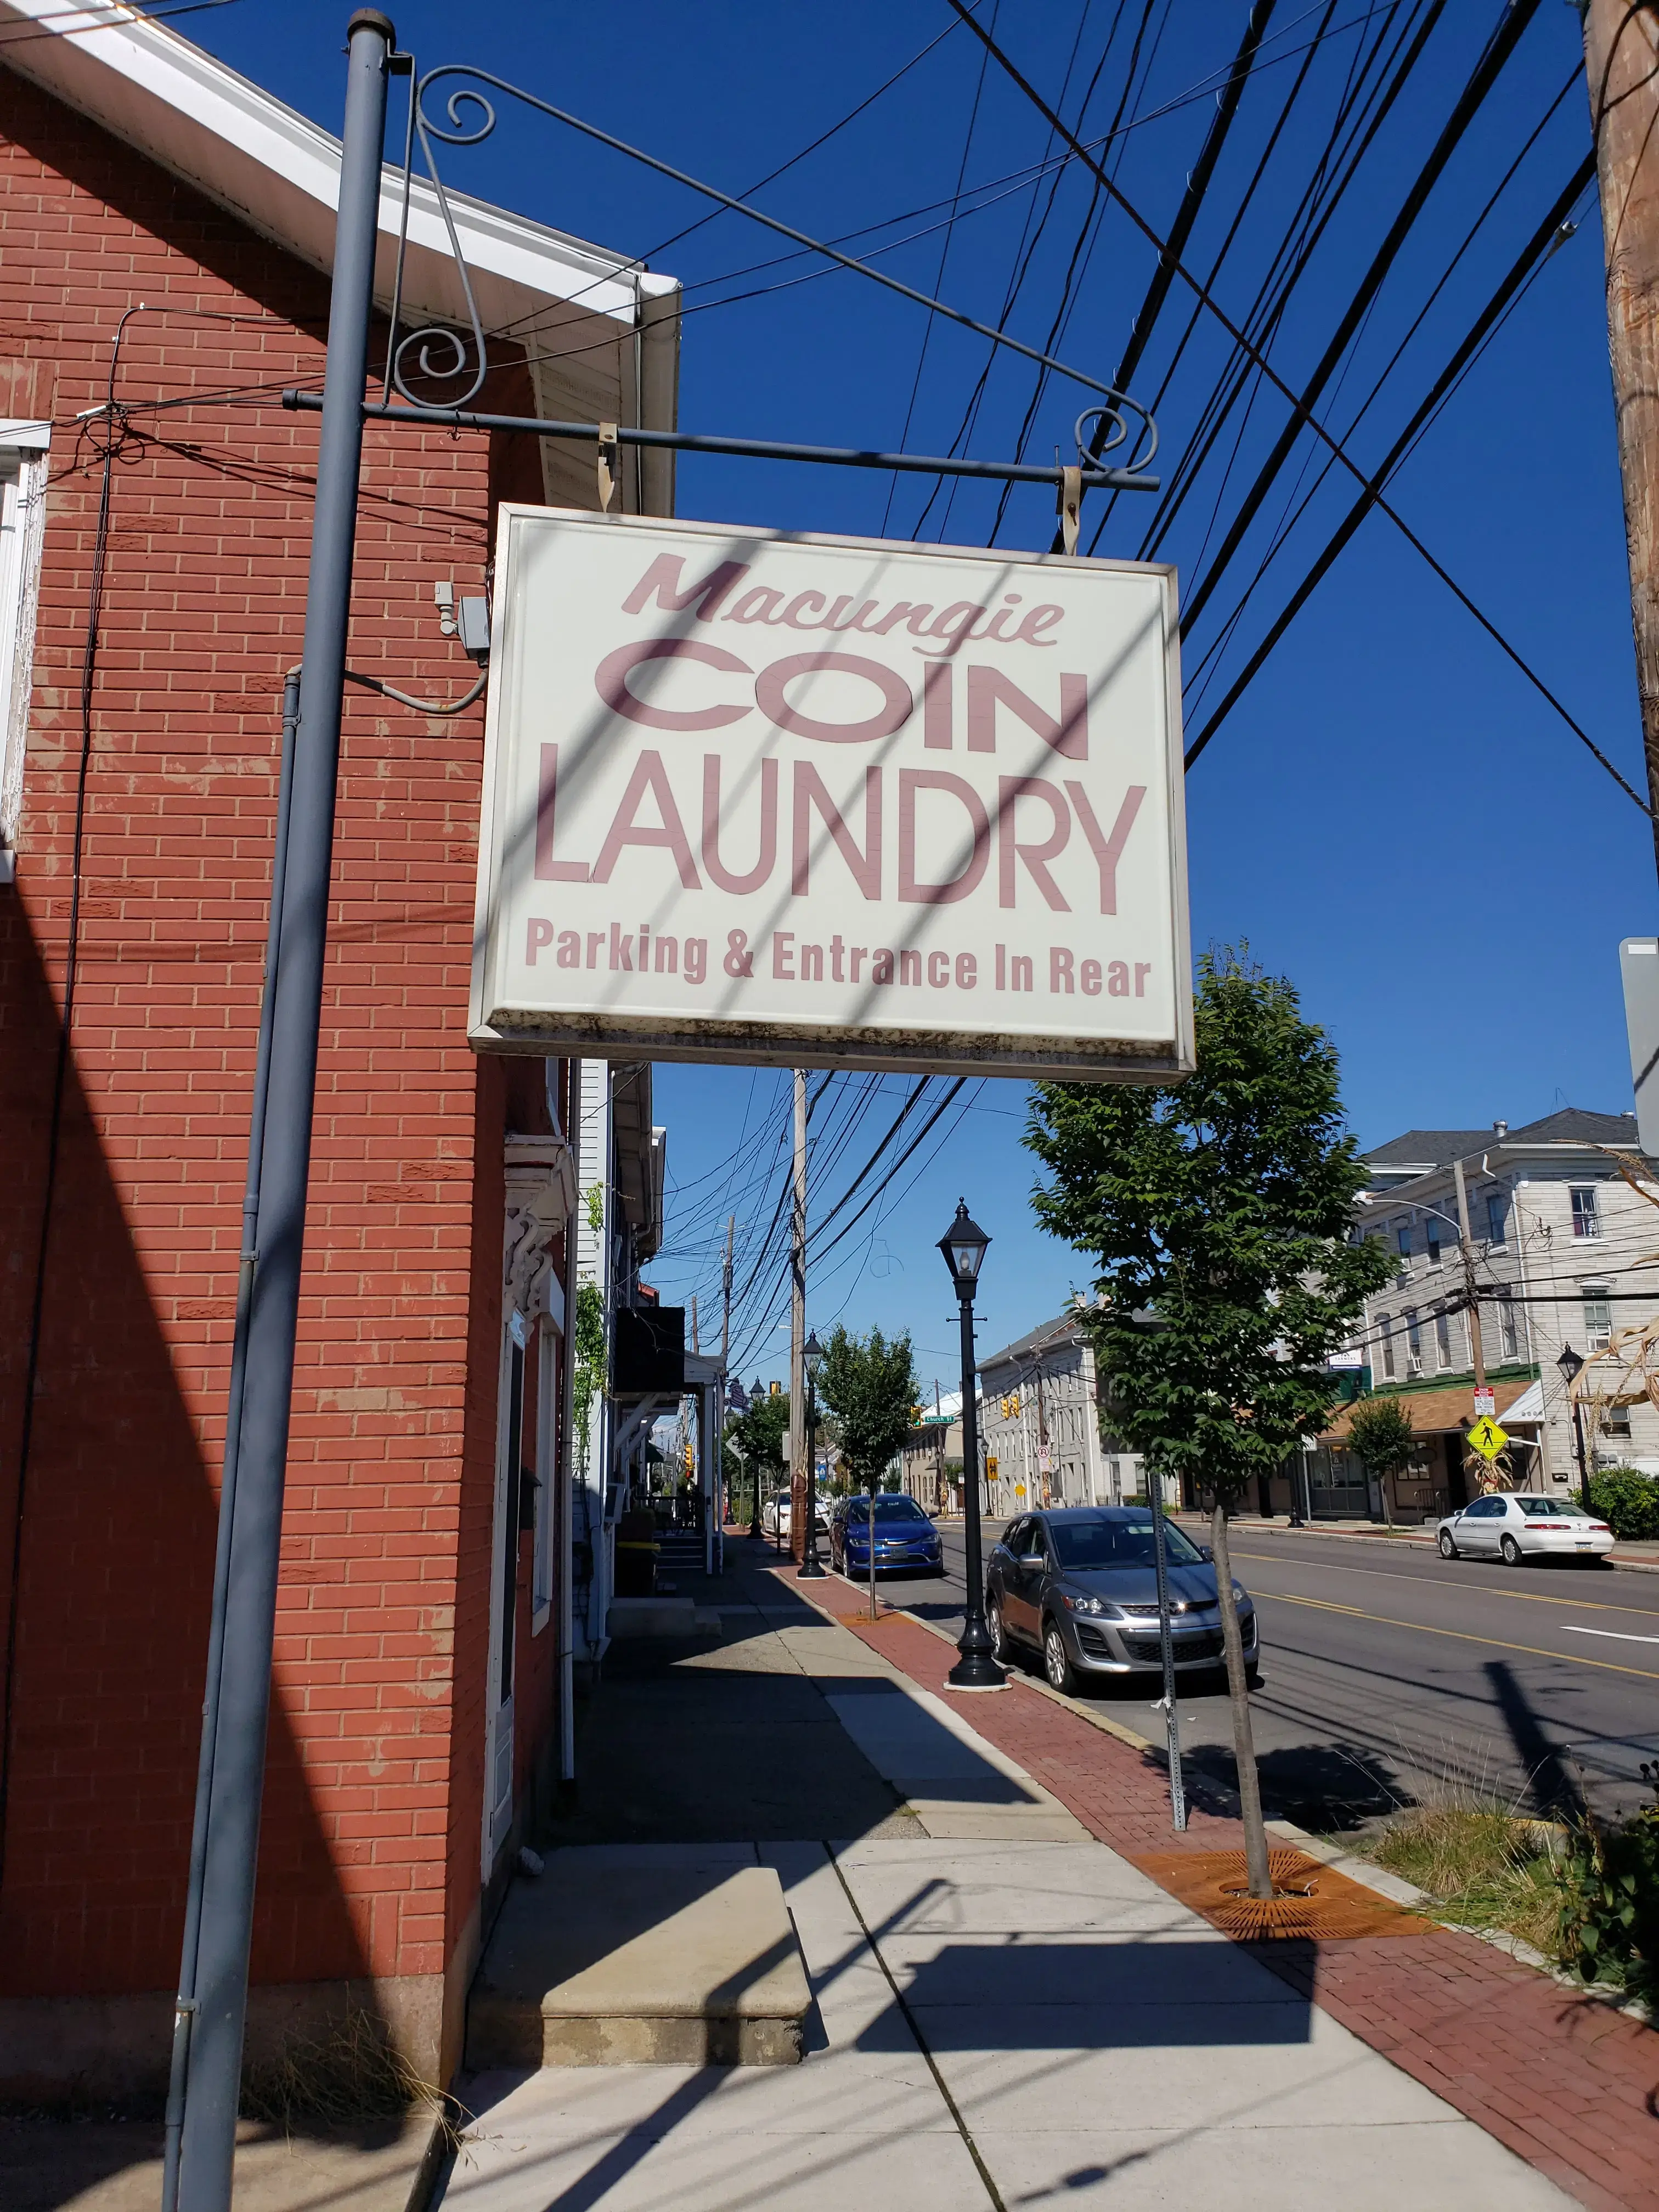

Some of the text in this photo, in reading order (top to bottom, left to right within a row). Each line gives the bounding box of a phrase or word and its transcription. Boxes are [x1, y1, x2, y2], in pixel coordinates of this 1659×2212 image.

[621, 552, 1064, 656] Macungie
[594, 638, 1089, 761] COIN
[533, 743, 1147, 915] LAUNDRY
[526, 918, 1152, 998] Parking & Entrance In Rear
